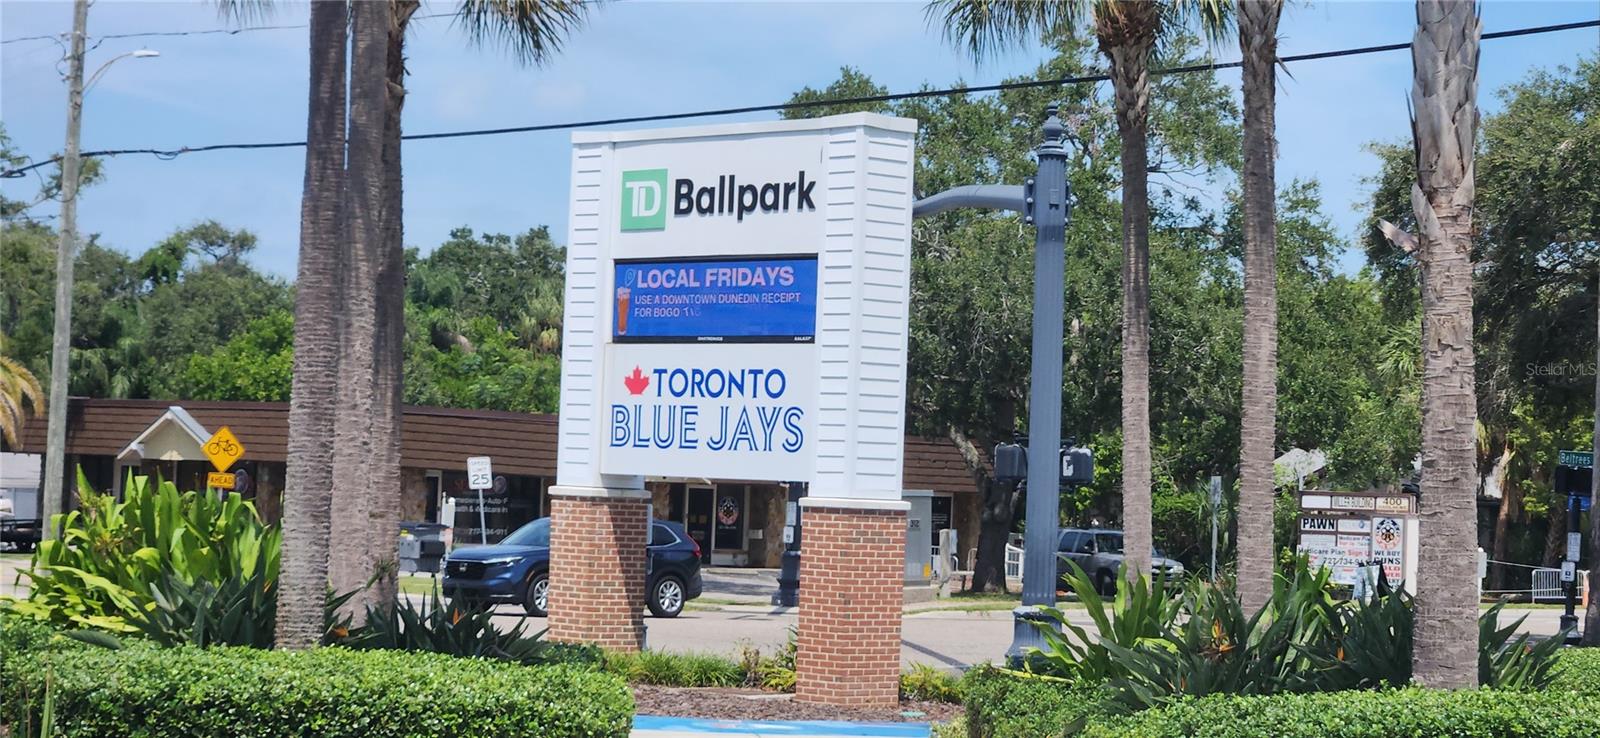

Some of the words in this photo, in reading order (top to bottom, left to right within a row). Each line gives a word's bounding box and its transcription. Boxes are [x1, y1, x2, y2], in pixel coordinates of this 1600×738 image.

[625, 180, 662, 218] TD
[674, 171, 816, 222] Ballpark
[637, 269, 700, 288] LOCAL
[705, 266, 794, 287] FRIDAYS
[634, 295, 651, 305] USE
[654, 295, 660, 304] A
[662, 294, 717, 305] DOWNTOWN
[718, 293, 759, 304] DUNEDIN
[762, 292, 801, 303] RECEIPT
[634, 307, 652, 317] FOR
[653, 306, 680, 317] BOGO
[653, 368, 786, 399] TORONTO
[610, 404, 699, 449] BLUE
[706, 405, 804, 453] JAYS
[1560, 452, 1592, 465] Beltrees
[210, 475, 233, 485] AHEAD
[472, 473, 490, 485] 25
[1383, 497, 1402, 506] 400
[1302, 518, 1335, 530] PAWN
